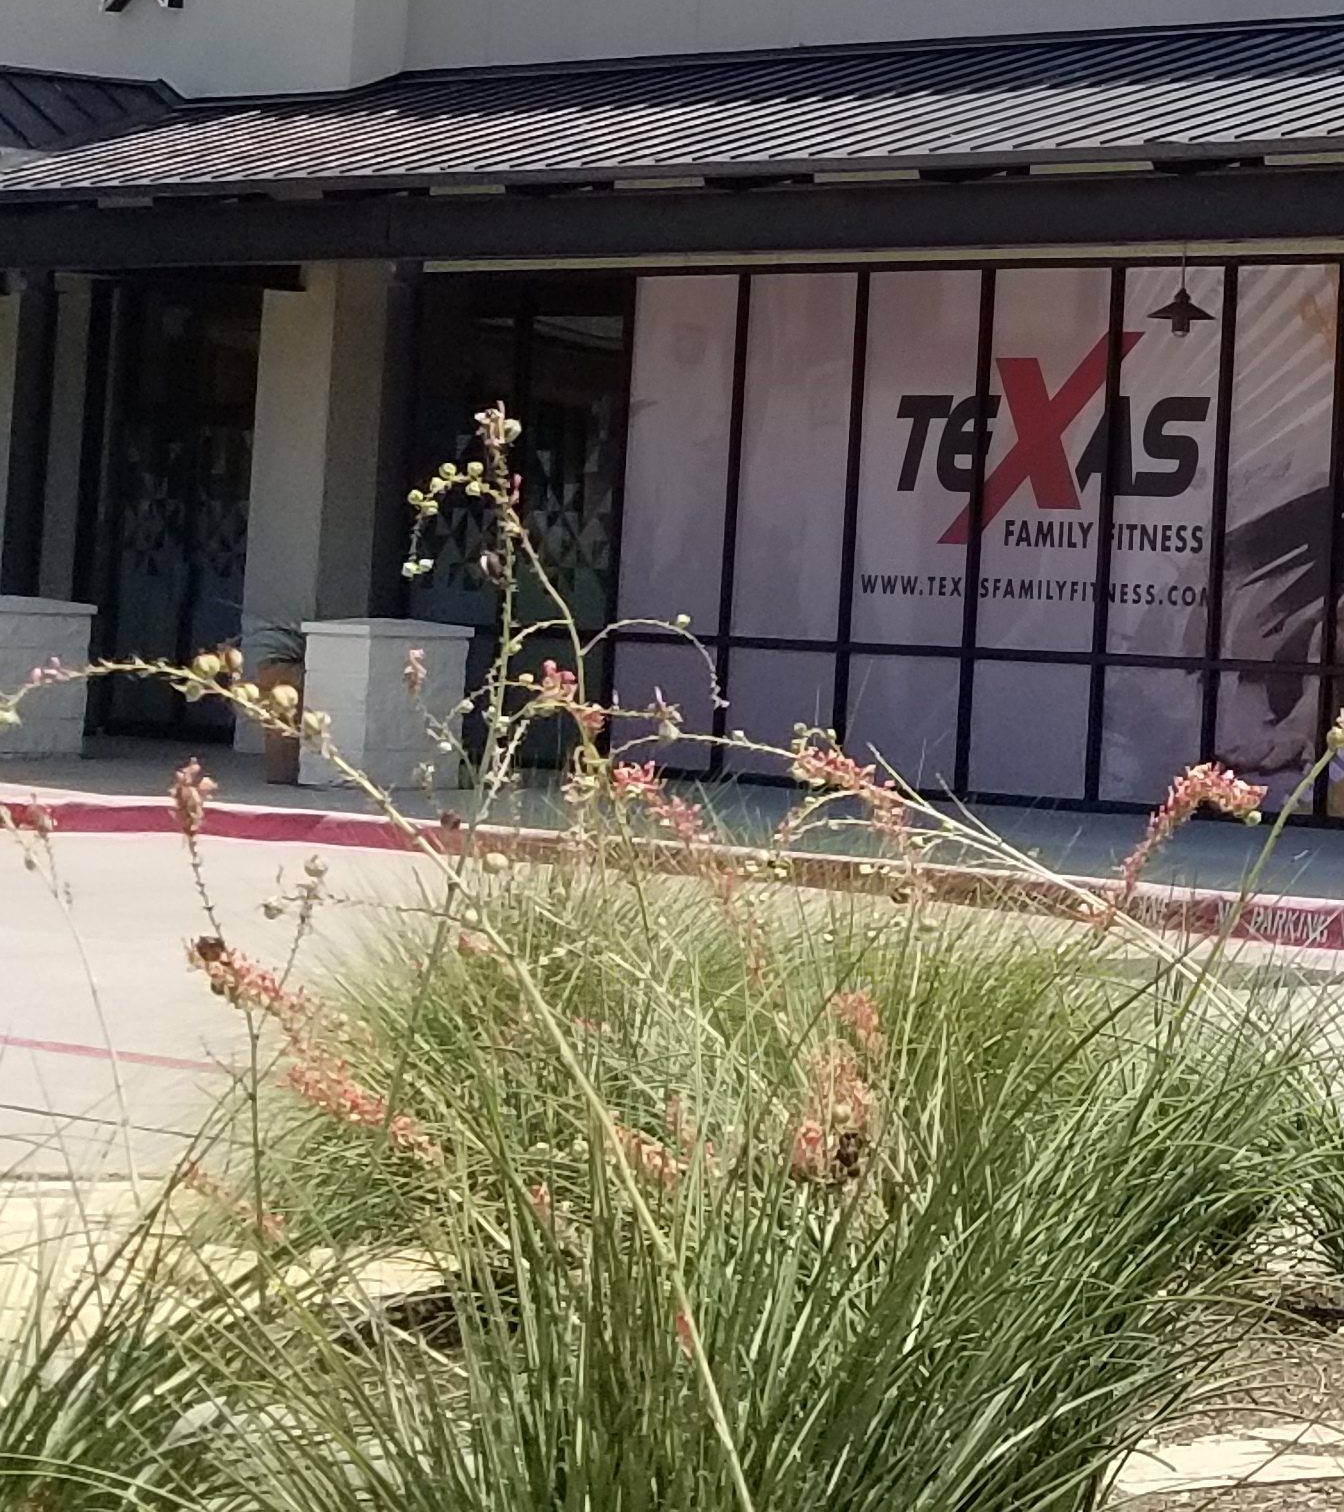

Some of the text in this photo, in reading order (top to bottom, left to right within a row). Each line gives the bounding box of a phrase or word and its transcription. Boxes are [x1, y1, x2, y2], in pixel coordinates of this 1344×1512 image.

[896, 331, 1211, 545] TEXAS
[1003, 519, 1204, 554] FAMILY ITNESS
[860, 574, 1209, 608] WWW.TEXSFAMILYFITNESS.COM
